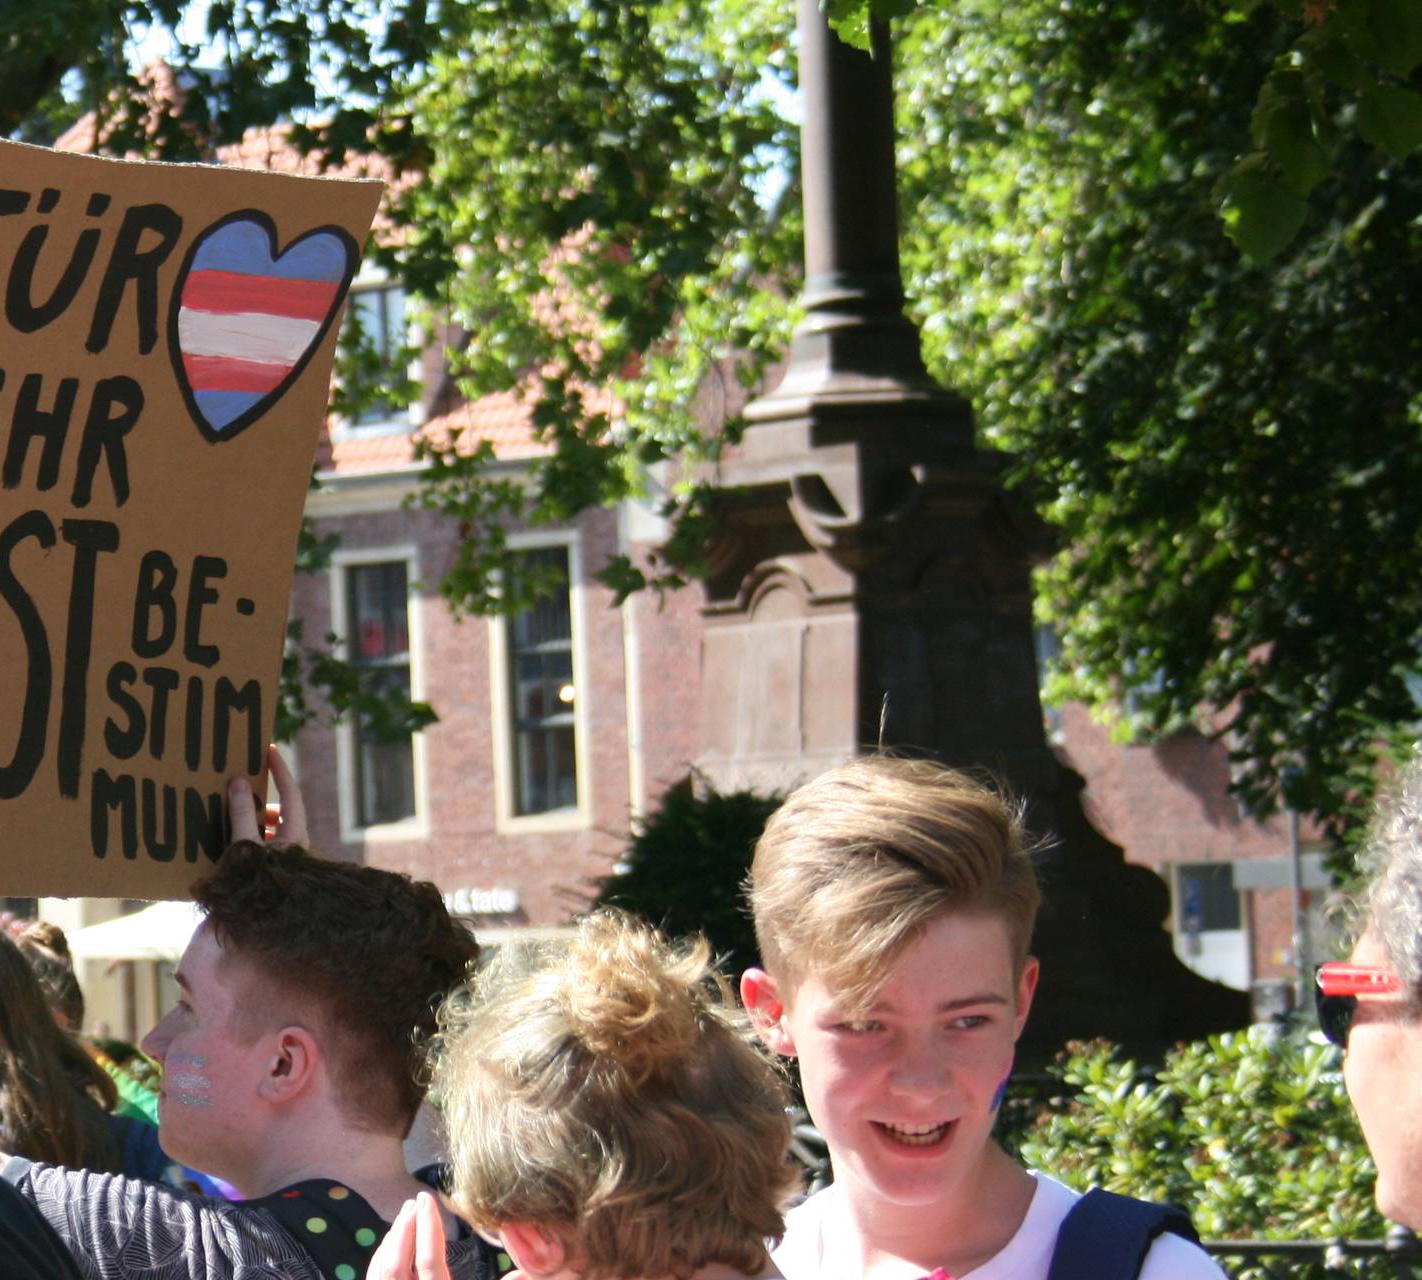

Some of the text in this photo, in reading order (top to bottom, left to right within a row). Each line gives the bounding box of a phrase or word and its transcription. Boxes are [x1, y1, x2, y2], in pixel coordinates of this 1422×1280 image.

[131, 550, 256, 668] BE-
[104, 660, 262, 776] STIM
[91, 769, 266, 863] MUN
